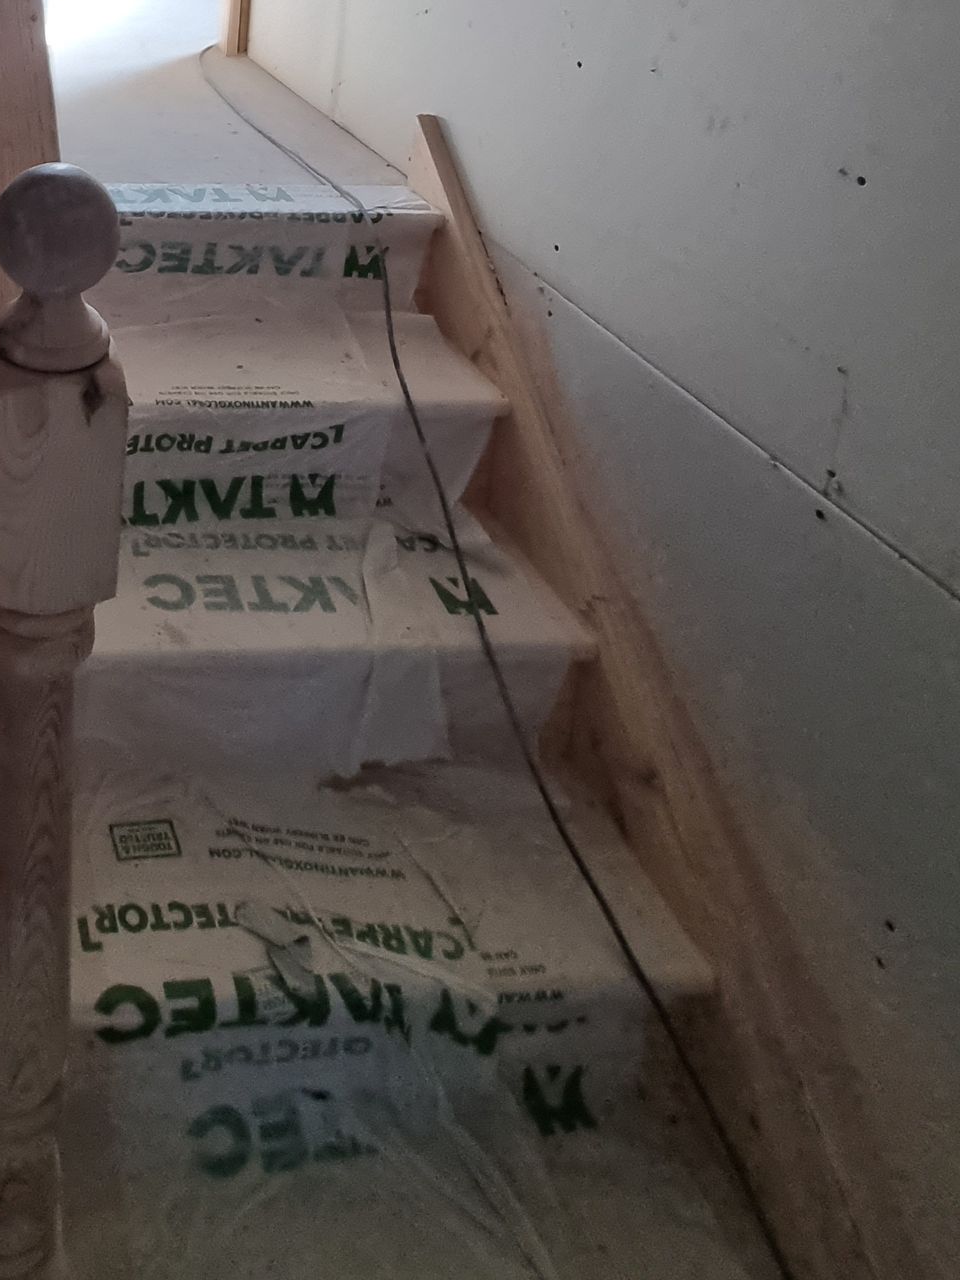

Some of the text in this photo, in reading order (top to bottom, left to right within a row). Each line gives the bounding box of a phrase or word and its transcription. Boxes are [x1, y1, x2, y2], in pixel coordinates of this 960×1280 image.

[115, 241, 326, 278] TAKTEC
[126, 433, 214, 456] PROTE
[121, 474, 277, 527] TAKT
[331, 915, 466, 961] CARPE
